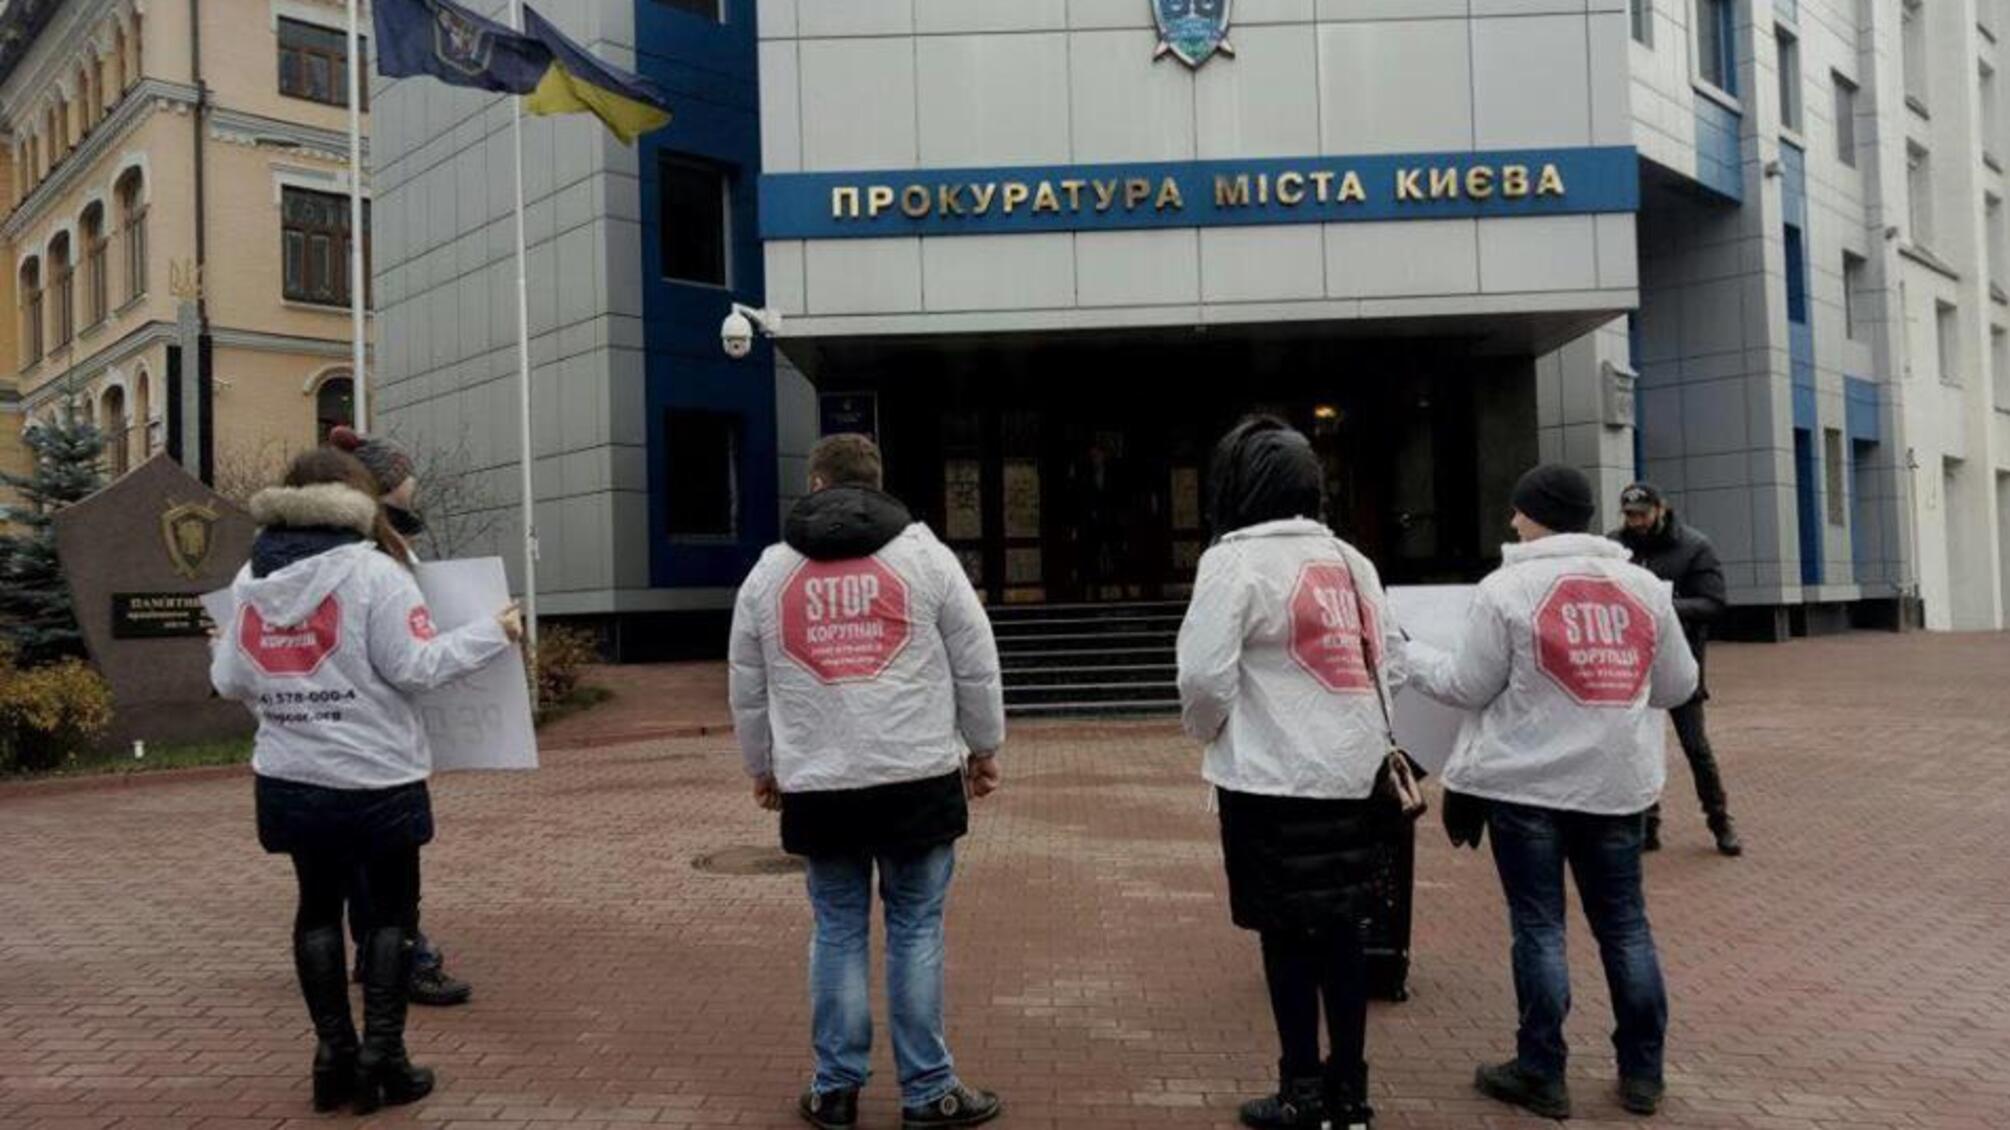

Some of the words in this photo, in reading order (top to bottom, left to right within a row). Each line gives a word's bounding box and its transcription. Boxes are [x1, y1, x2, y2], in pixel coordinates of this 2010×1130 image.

[831, 176, 1184, 218] ПРОКУРАТУРА
[1214, 170, 1367, 207] МІСТА
[1396, 163, 1565, 200] КИЄВА
[805, 573, 878, 621] STOP
[1562, 602, 1631, 645] STOP
